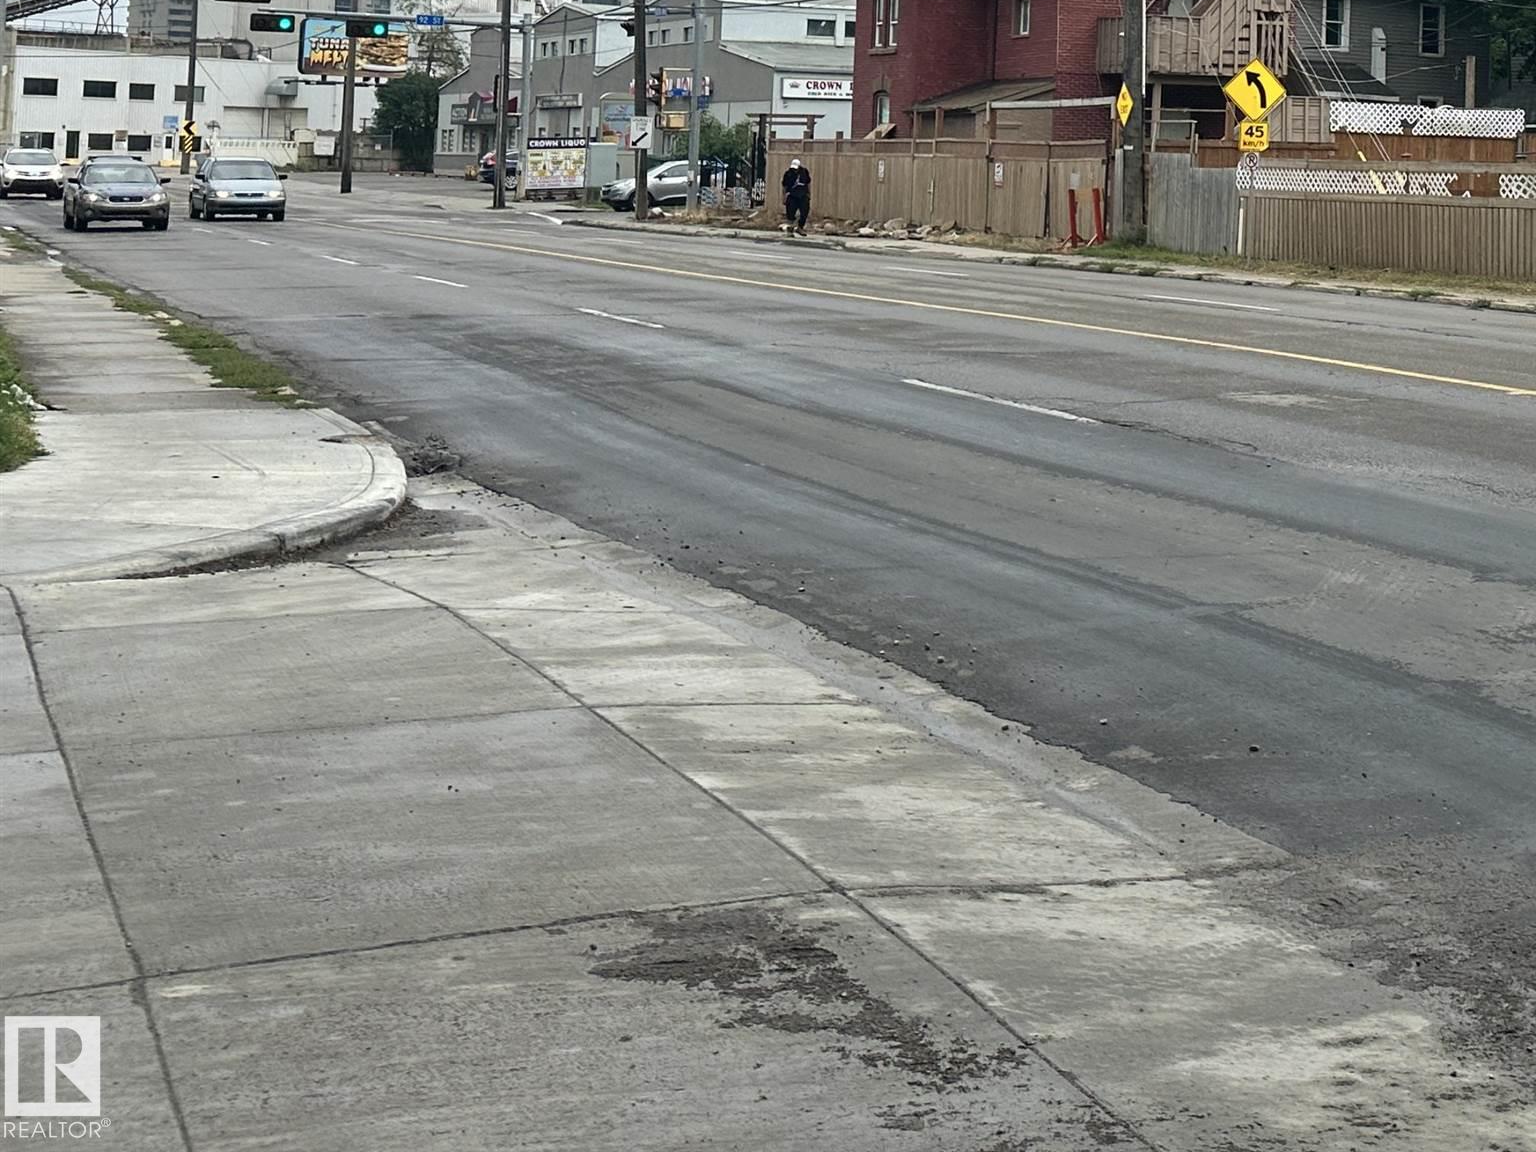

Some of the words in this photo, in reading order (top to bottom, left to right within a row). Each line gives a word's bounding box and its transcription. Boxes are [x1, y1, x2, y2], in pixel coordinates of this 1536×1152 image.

[418, 16, 429, 24] 92
[309, 38, 350, 49] TUNA
[310, 50, 349, 67] MELT
[806, 81, 842, 90] CROWN
[1244, 126, 1264, 138] 45
[561, 139, 586, 147] LIQUO
